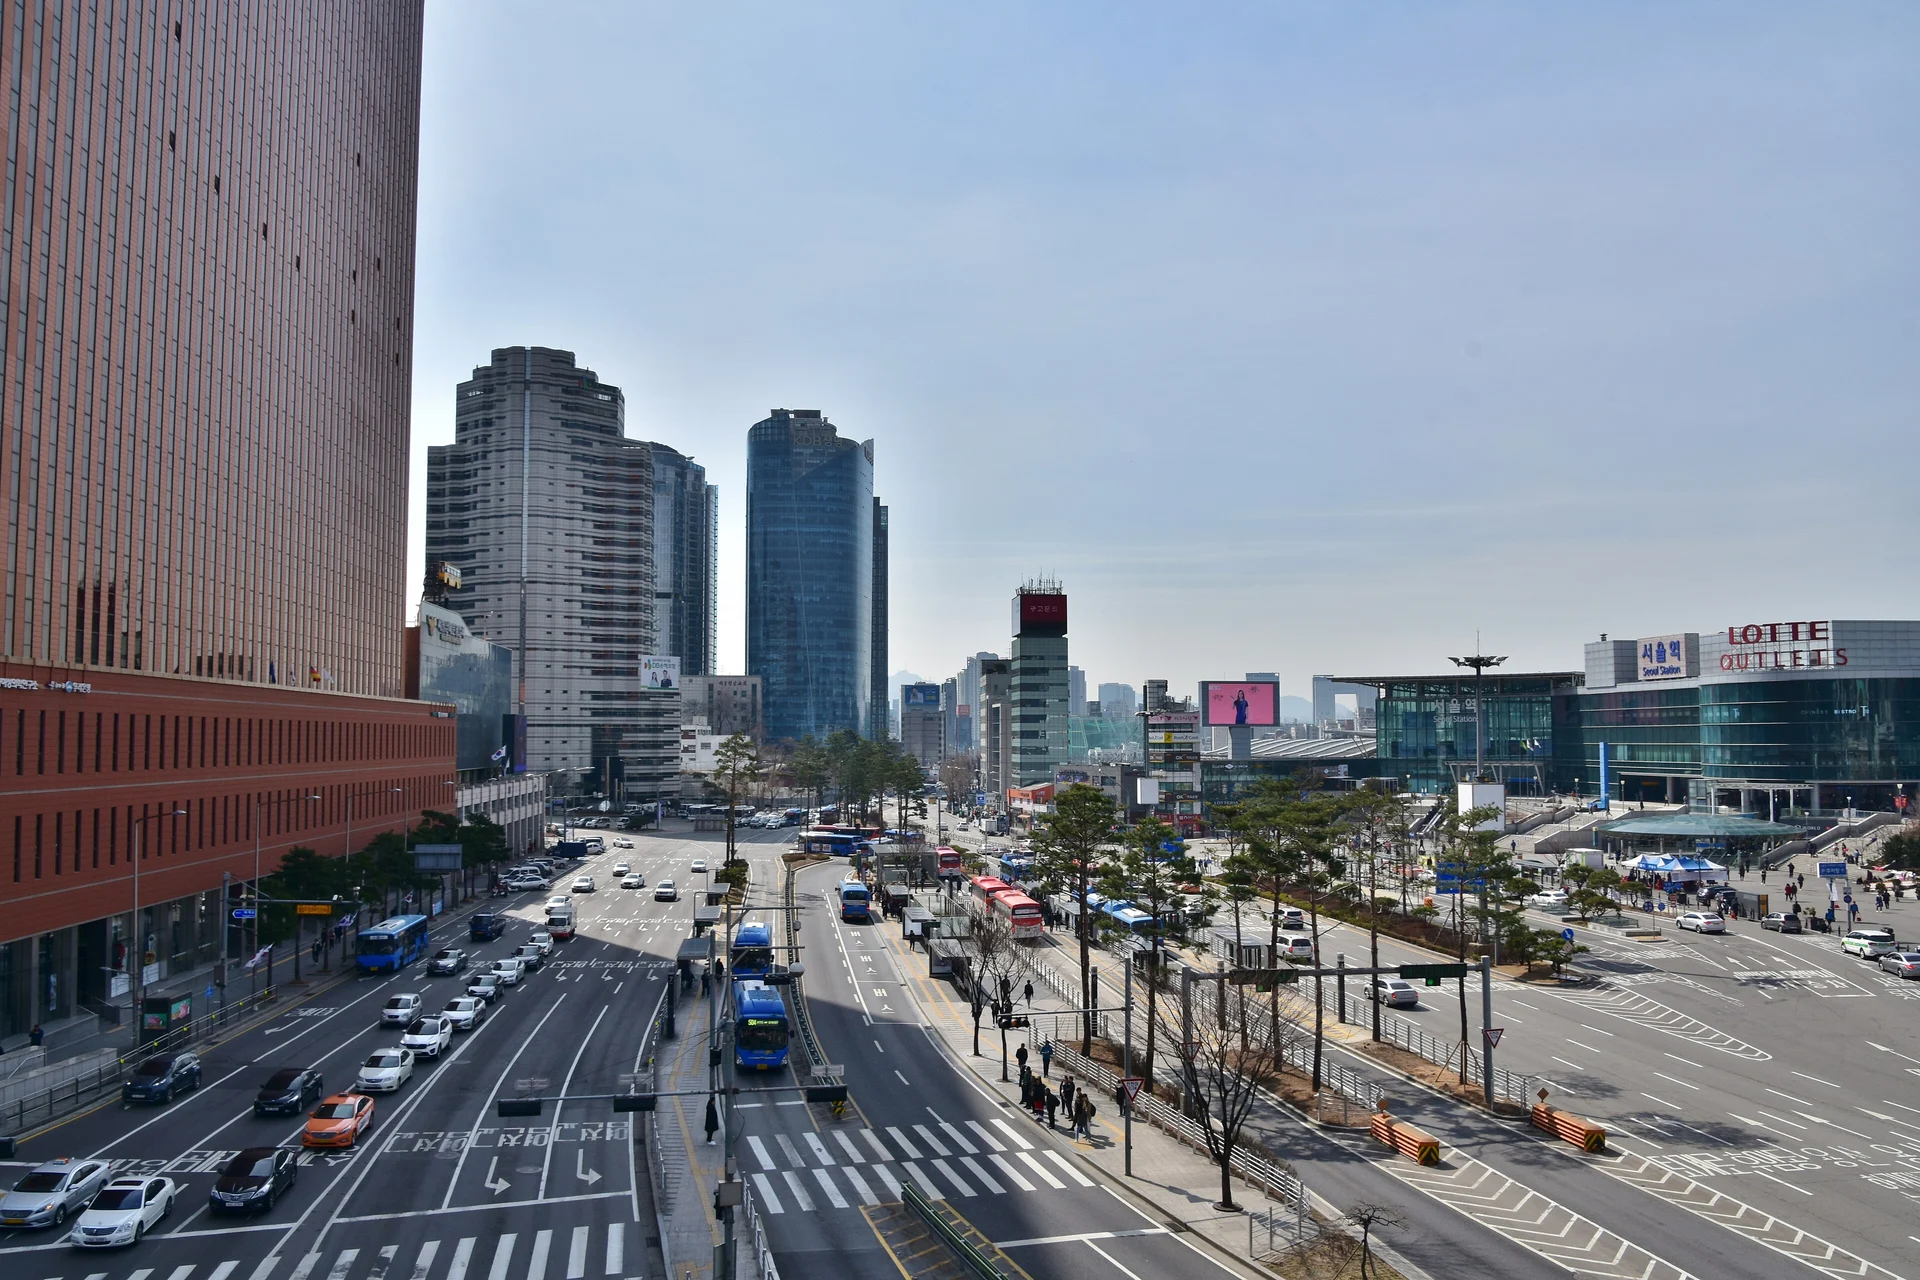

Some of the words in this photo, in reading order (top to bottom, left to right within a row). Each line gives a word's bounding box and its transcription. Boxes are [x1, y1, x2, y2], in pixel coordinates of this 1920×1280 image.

[1729, 621, 1829, 645] LOTTE
[1642, 640, 1681, 664] 서울역
[1720, 648, 1849, 671] OUTLETS
[1642, 667, 1659, 677] Seoul
[1660, 665, 1681, 676] Station
[1434, 698, 1477, 713] 서울역
[383, 1131, 470, 1153] 염천교
[470, 1127, 551, 1148] 염천교
[554, 1122, 629, 1142] 염천교
[1645, 1152, 1753, 1178] 퇴계로
